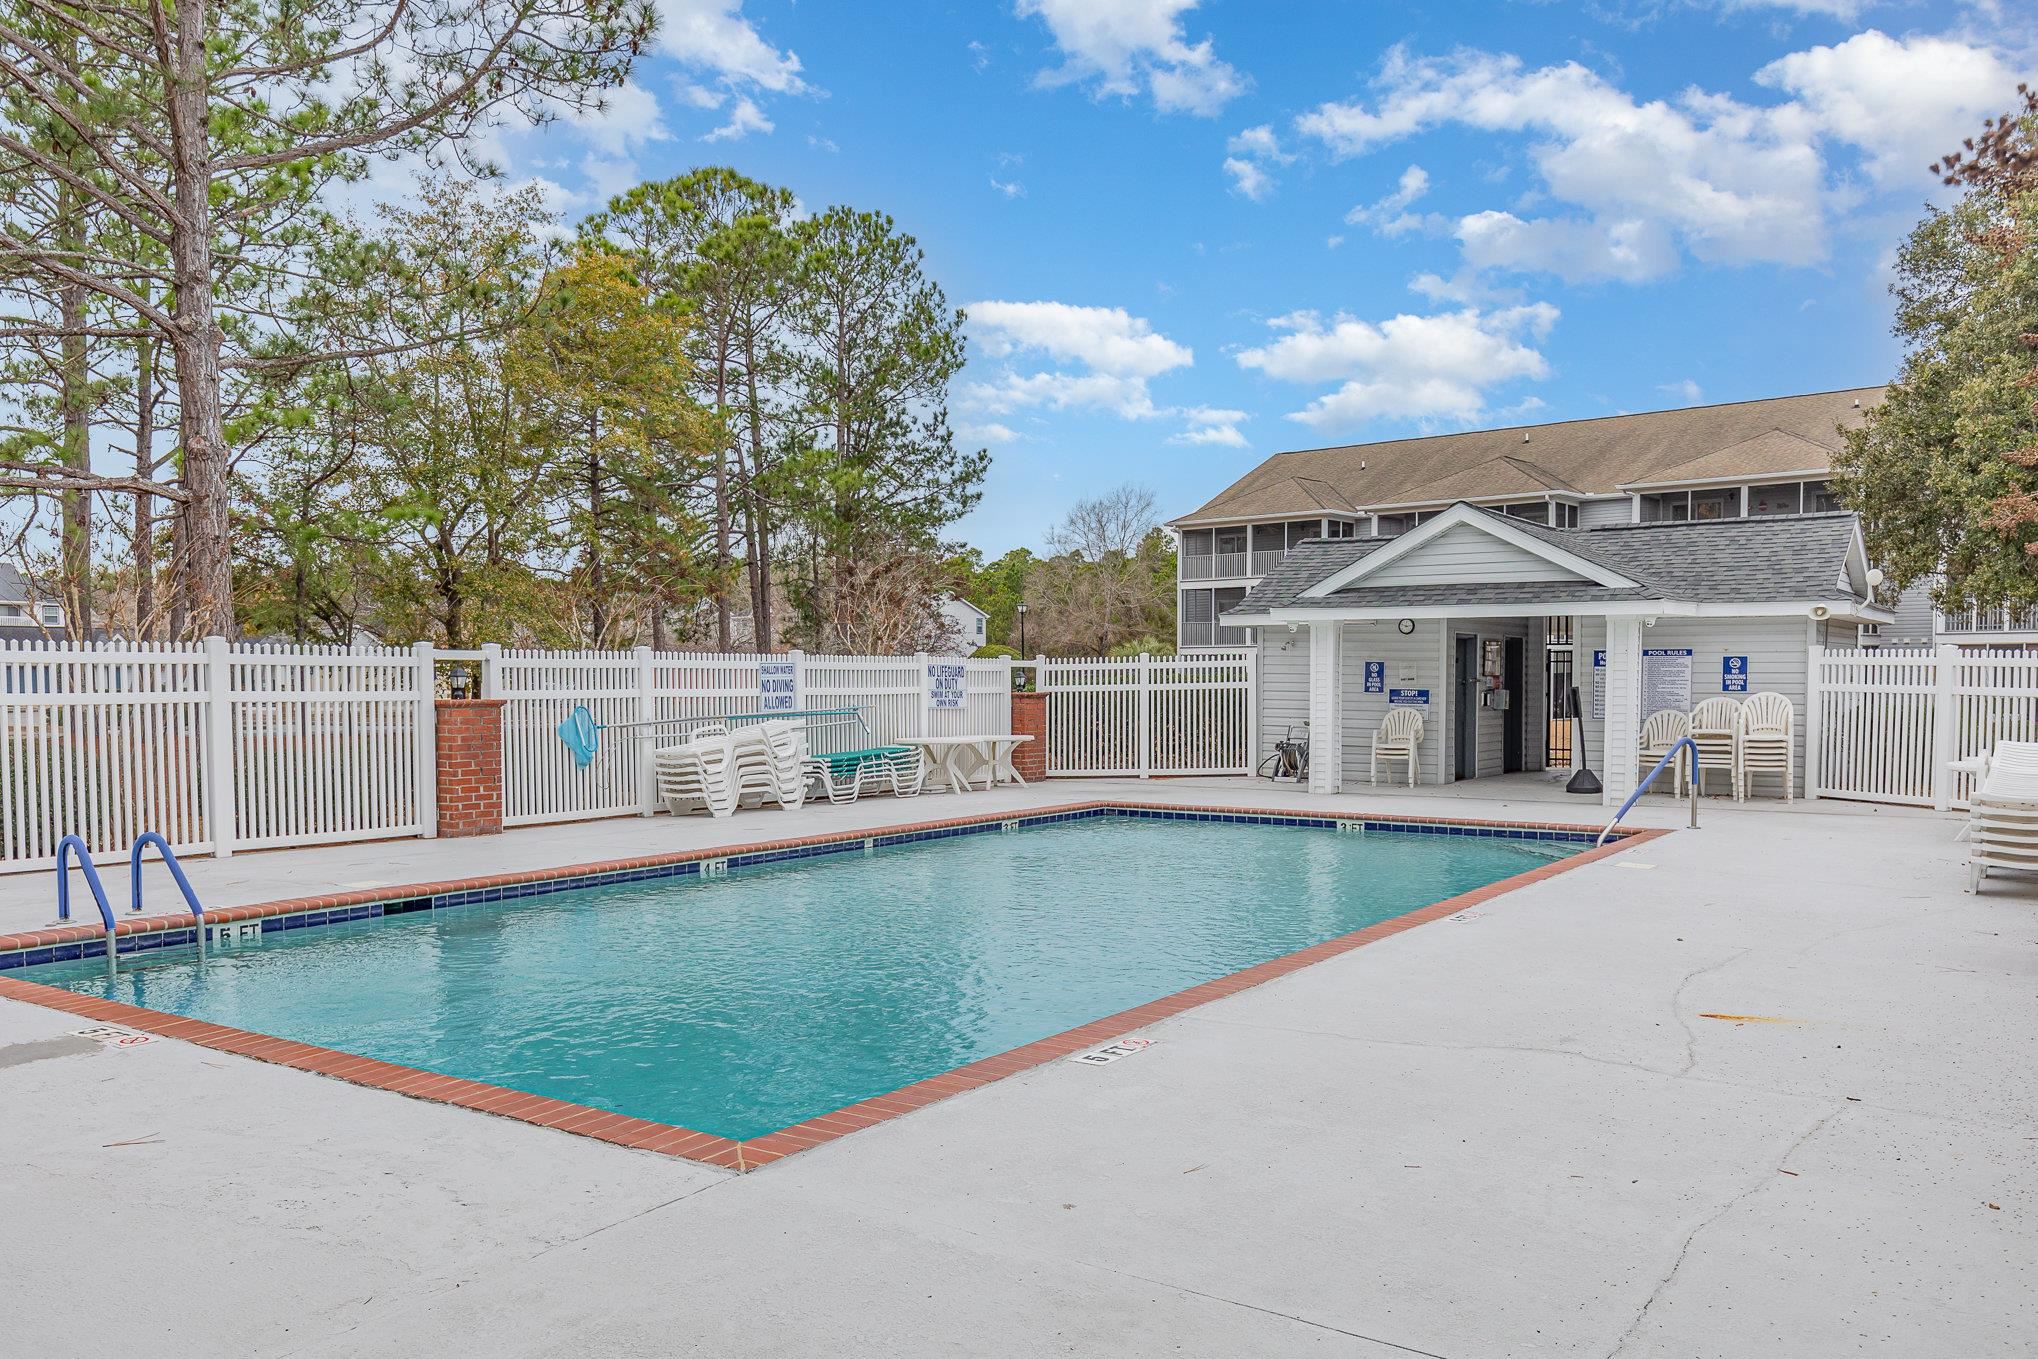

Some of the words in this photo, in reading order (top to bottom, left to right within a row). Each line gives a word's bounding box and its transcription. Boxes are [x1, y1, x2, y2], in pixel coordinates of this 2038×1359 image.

[761, 665, 779, 675] SHALLOW
[780, 665, 793, 675] WATER
[928, 665, 936, 677] NO
[936, 665, 965, 678] LIFEGUARD
[761, 679, 770, 693] NO
[772, 679, 793, 693] DIVING
[935, 677, 944, 689] ON
[944, 677, 958, 690] DUTY
[931, 690, 943, 699] SWIM
[944, 690, 950, 699] AT
[951, 690, 963, 699] YOUR
[763, 696, 793, 709] ALLOWED
[936, 699, 947, 707] OWN
[948, 699, 959, 707] RISK
[715, 860, 727, 872] FT
[240, 923, 259, 938] FT
[1100, 1045, 1137, 1056] FT
